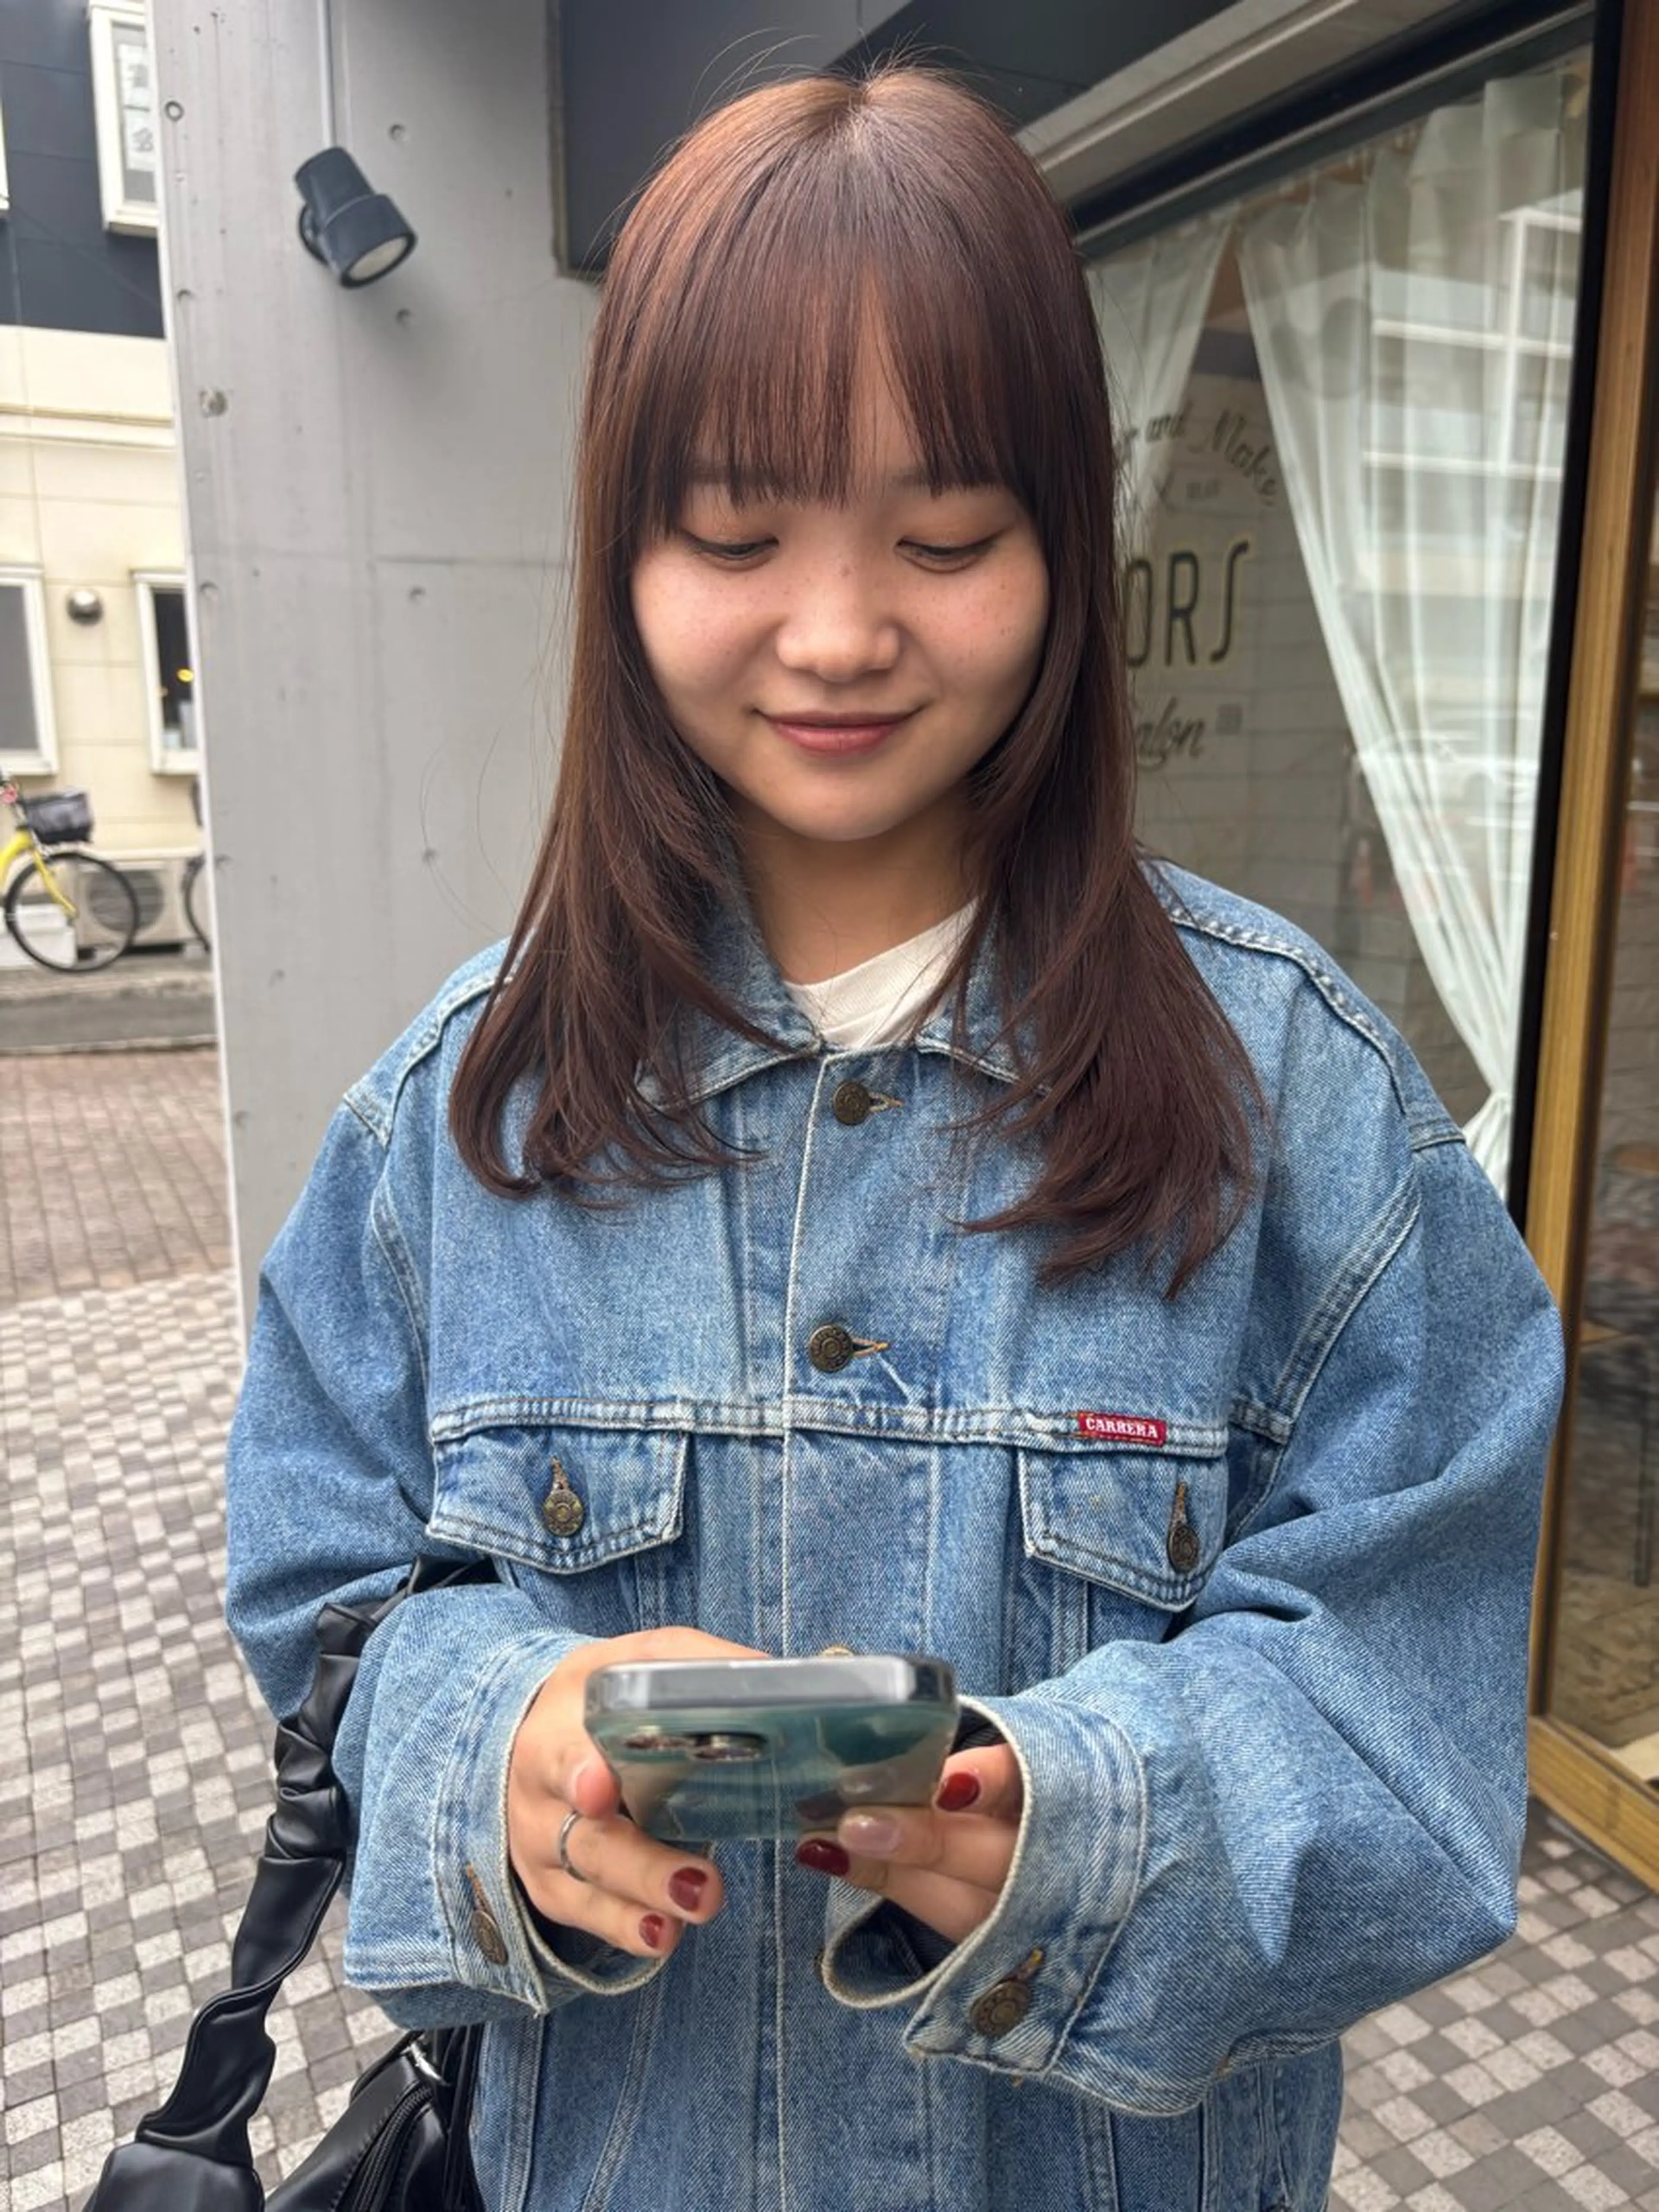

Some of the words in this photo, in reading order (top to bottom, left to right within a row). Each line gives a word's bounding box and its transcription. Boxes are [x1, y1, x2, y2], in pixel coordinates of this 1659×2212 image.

[1123, 541, 1249, 667] ORS
[1135, 696, 1206, 772] alon
[1085, 1417, 1158, 1438] CARRERA
